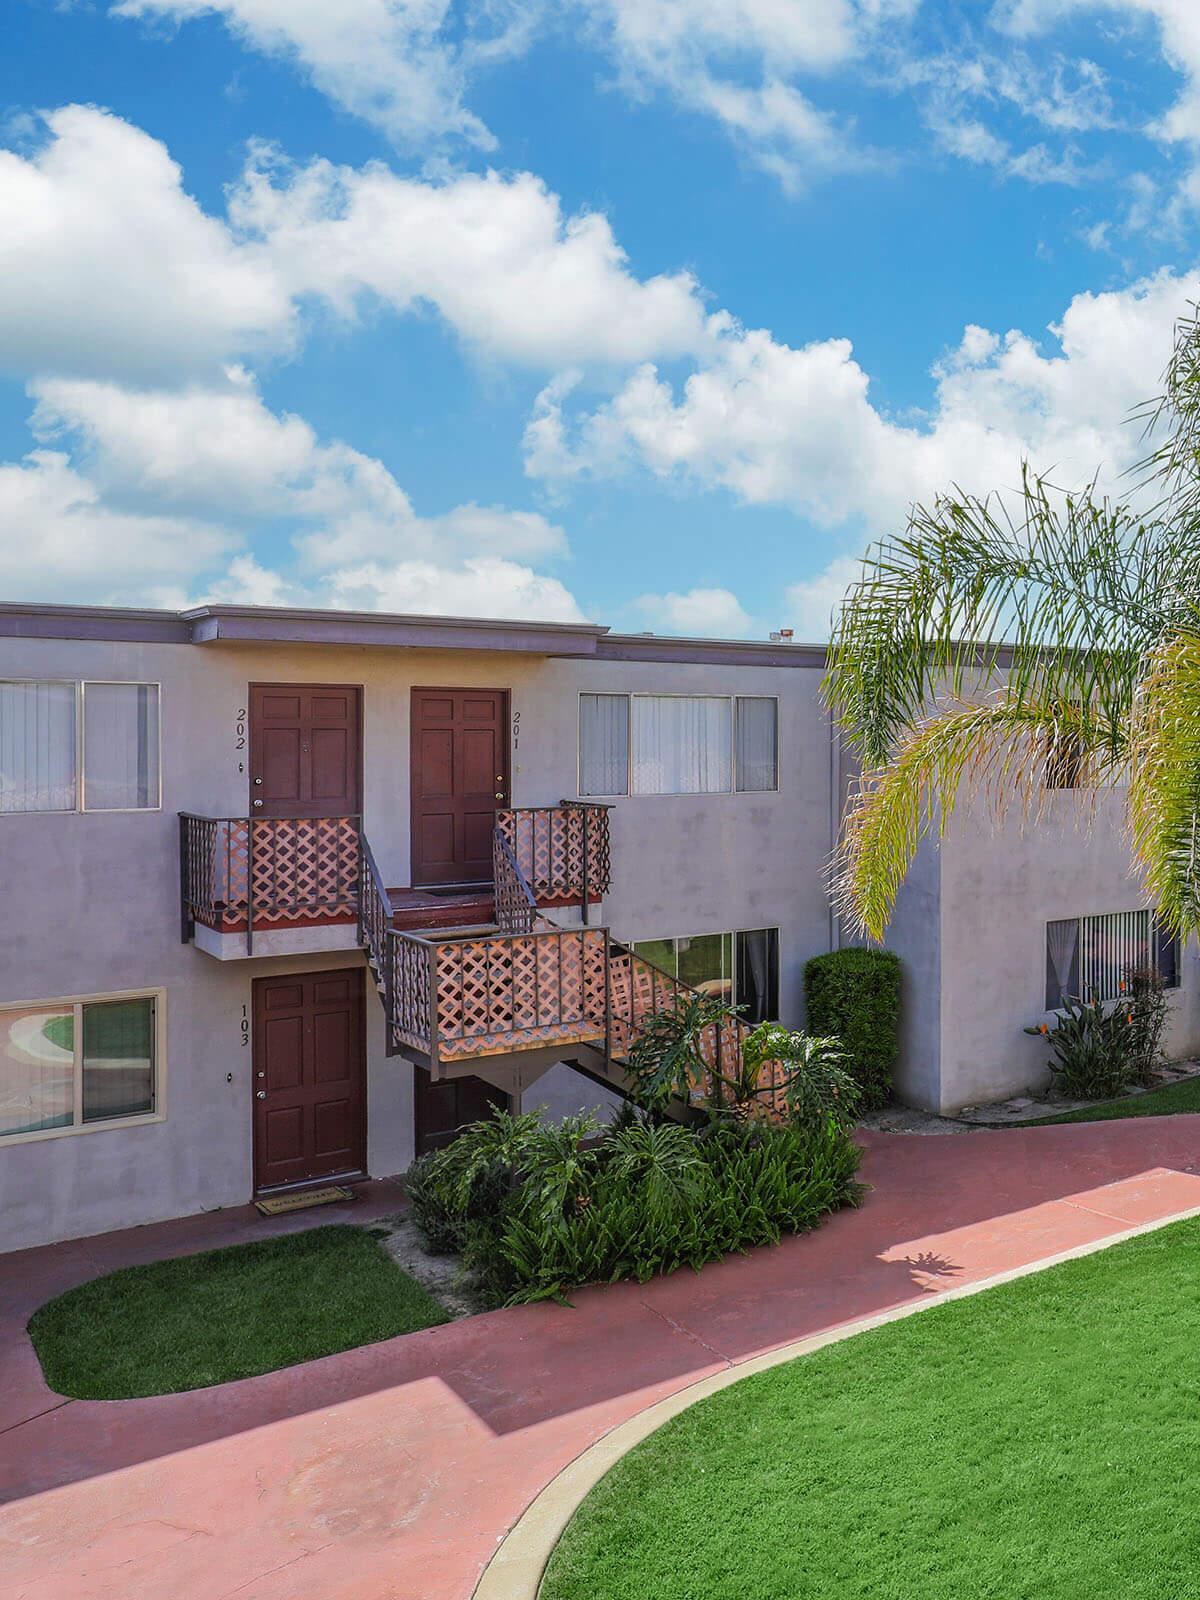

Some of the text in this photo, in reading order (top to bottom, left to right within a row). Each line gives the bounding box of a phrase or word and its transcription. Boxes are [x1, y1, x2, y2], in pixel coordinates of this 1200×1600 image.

[235, 708, 246, 749] 202
[513, 711, 521, 749] 201
[240, 1004, 249, 1047] 103
